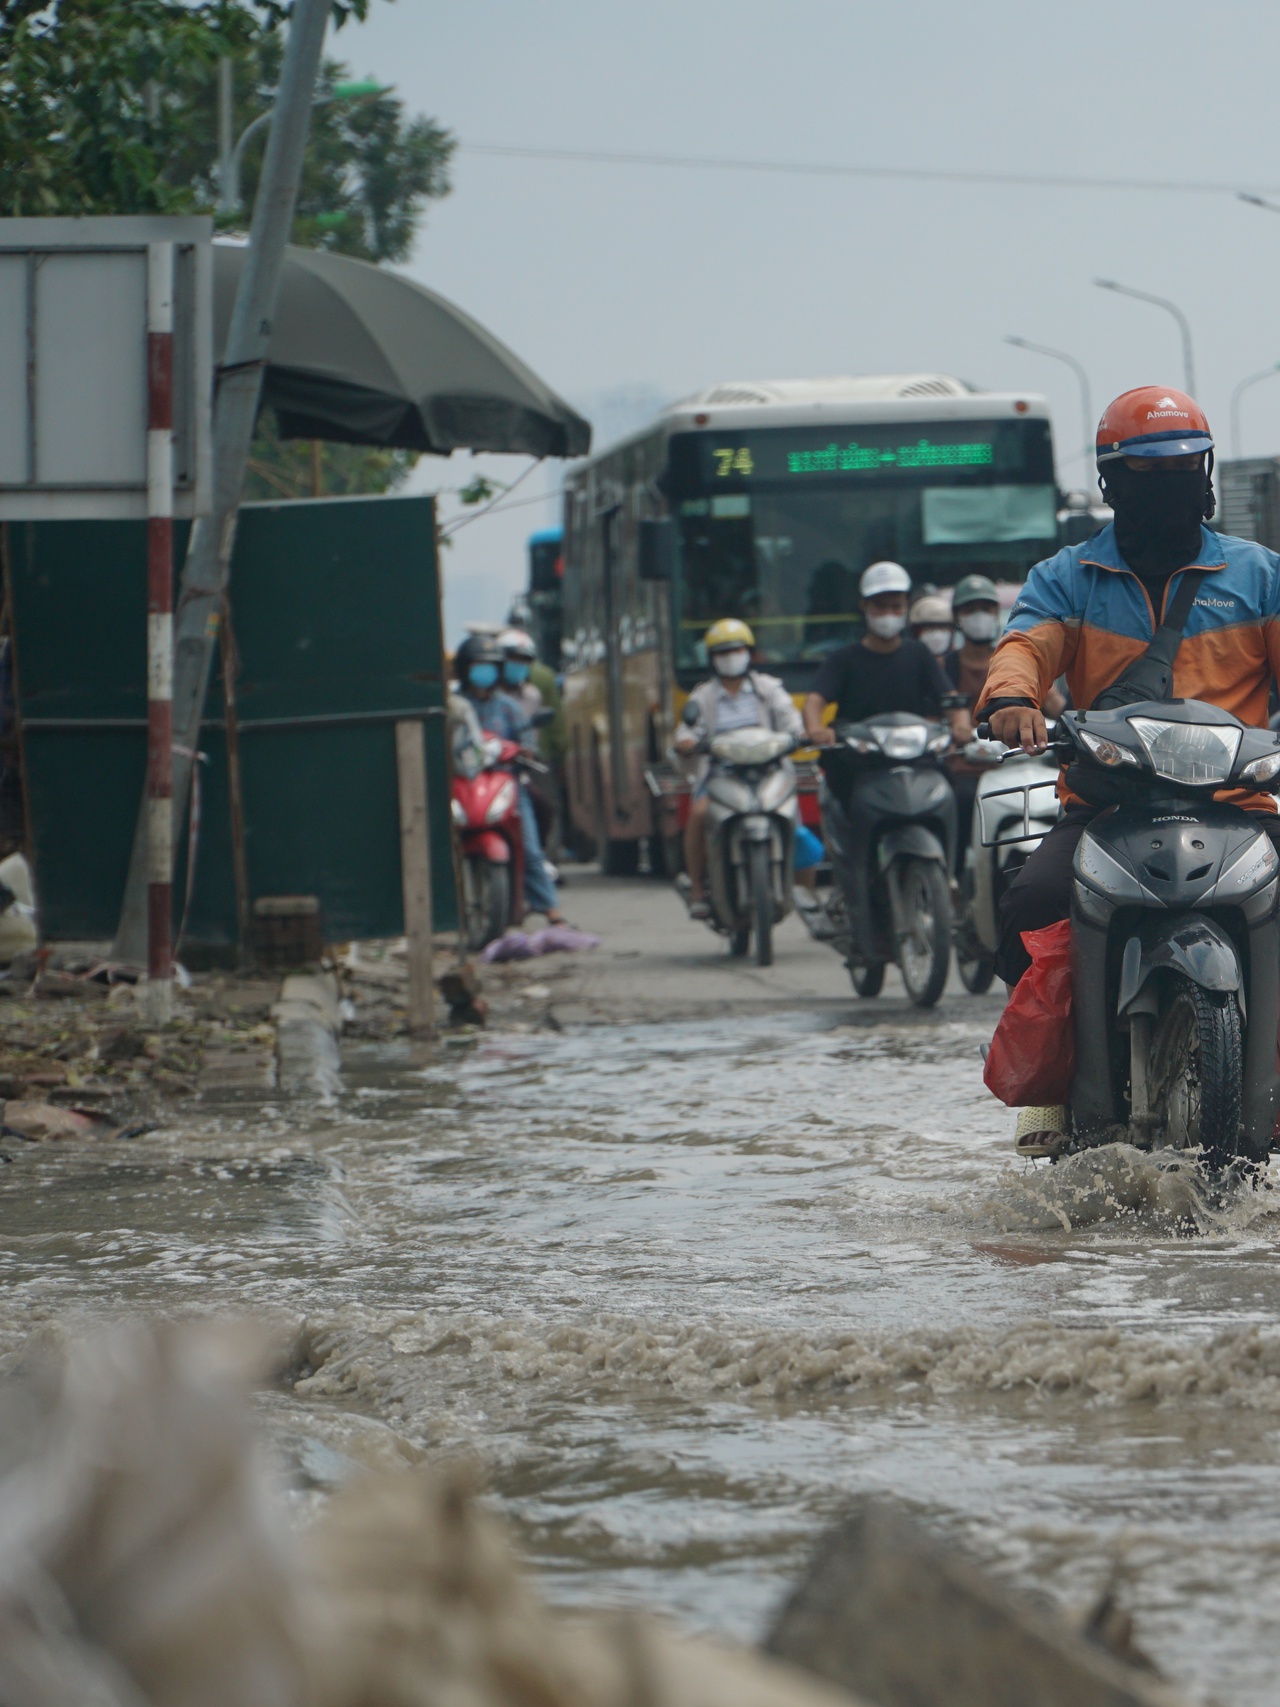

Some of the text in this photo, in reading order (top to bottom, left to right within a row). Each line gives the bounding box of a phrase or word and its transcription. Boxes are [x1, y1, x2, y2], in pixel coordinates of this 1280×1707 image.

[1147, 410, 1189, 420] Ahamove
[712, 447, 754, 476] 74
[1192, 597, 1235, 608] haMove
[1151, 815, 1200, 823] HONDA
